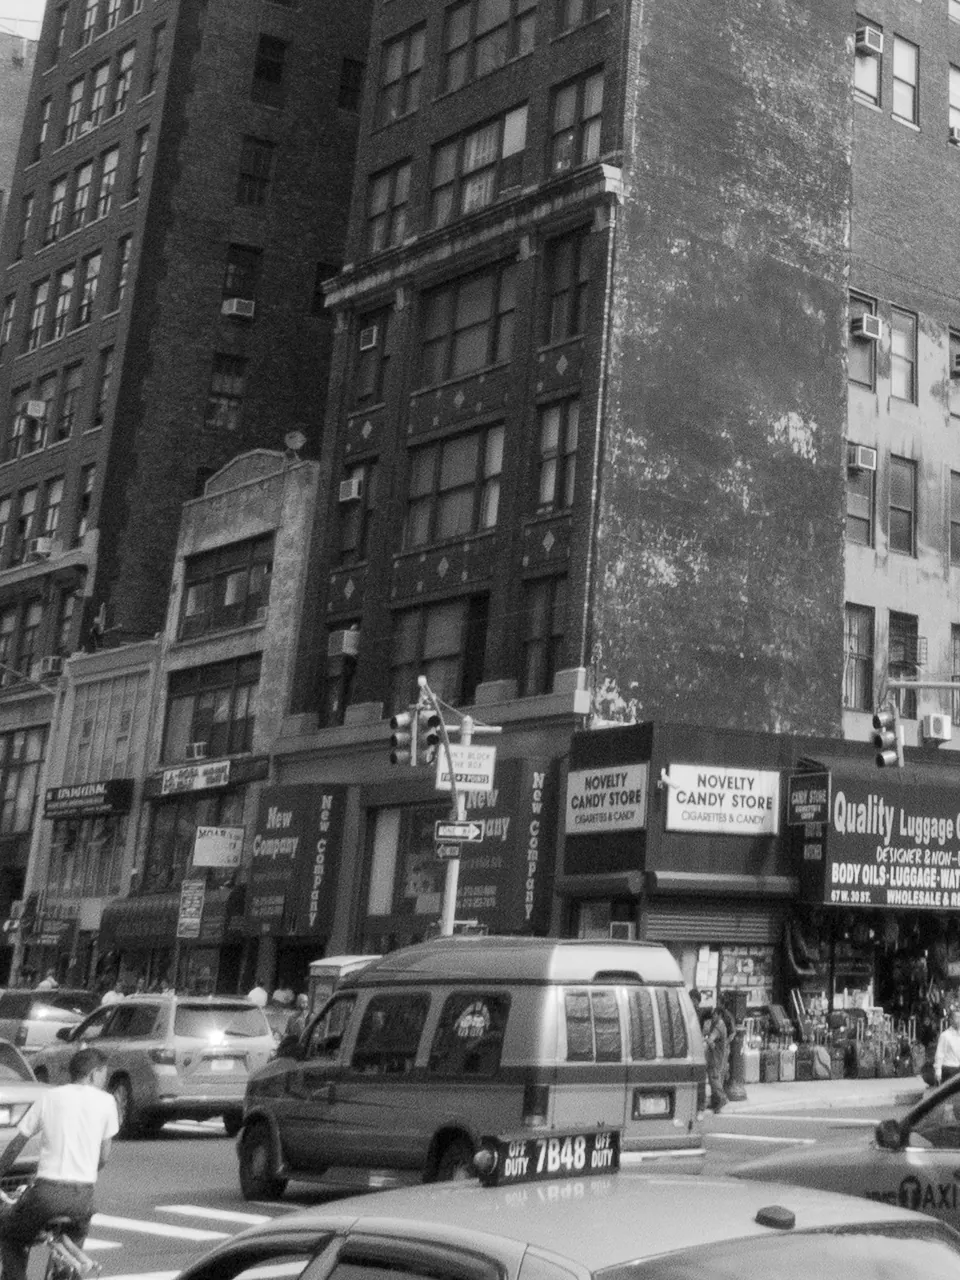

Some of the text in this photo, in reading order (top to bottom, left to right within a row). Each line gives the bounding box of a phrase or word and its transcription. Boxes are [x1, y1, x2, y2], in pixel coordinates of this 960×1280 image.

[585, 773, 628, 791] NOVELTY
[697, 773, 755, 791] NOVELTY
[571, 789, 642, 809] CANDY STORE
[676, 790, 773, 811] CANDY STORE
[681, 810, 766, 825] CIGARETTES & CANDY
[834, 791, 895, 846] Quality
[900, 808, 954, 845] Luggage
[253, 834, 299, 860] Company
[876, 845, 923, 865] DESIGNER
[924, 848, 931, 865] &
[524, 820, 540, 920] Company
[831, 862, 861, 884] BODY
[886, 889, 942, 905] WHOLESALE
[942, 891, 950, 907] &
[504, 1148, 613, 1177] DUTY DUTY
[508, 1131, 611, 1174] OFF 7B48 OFF
